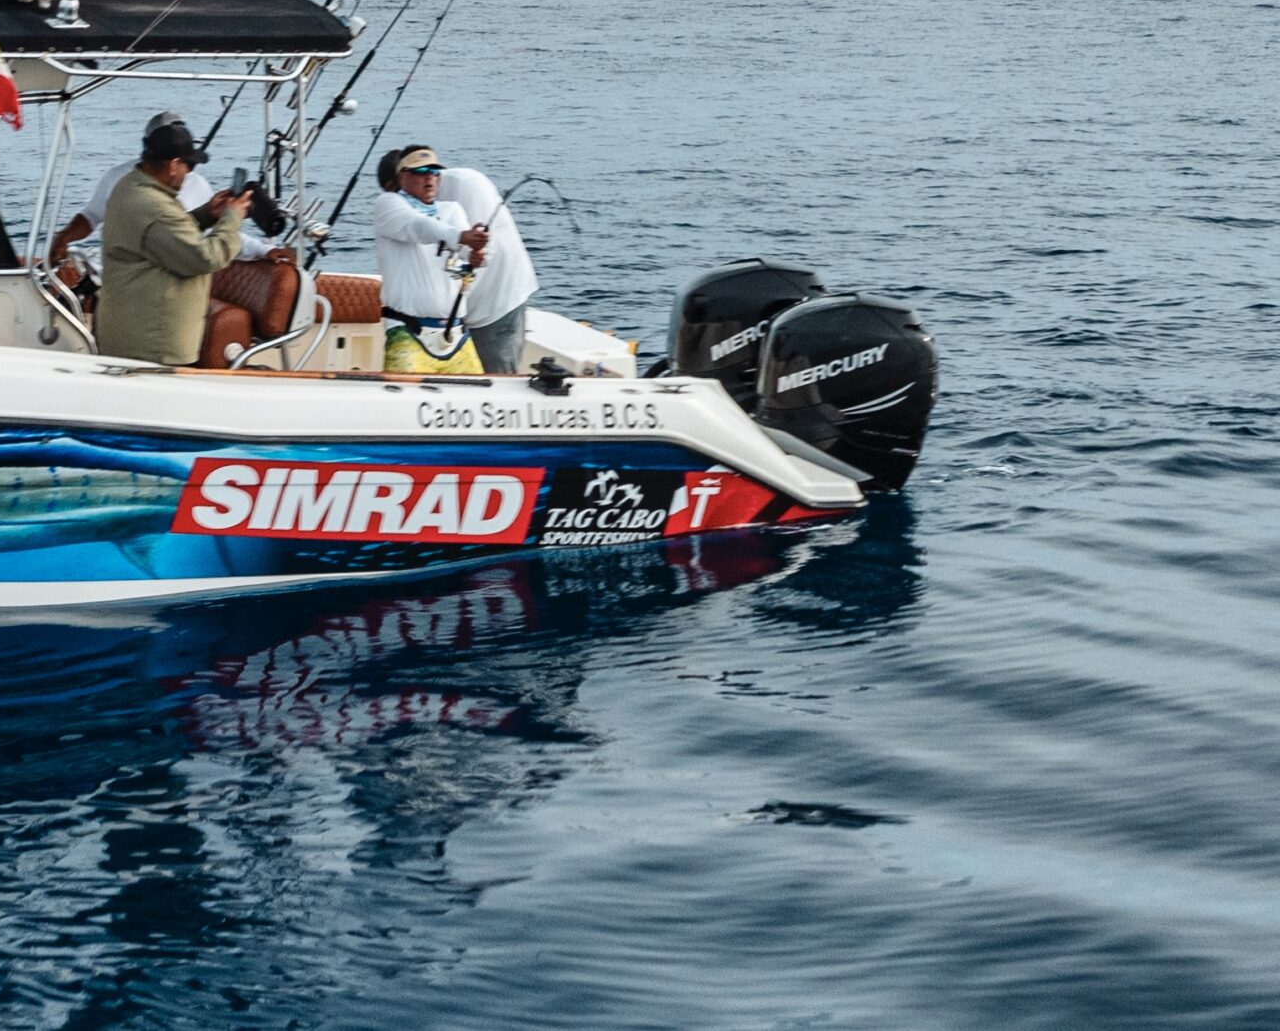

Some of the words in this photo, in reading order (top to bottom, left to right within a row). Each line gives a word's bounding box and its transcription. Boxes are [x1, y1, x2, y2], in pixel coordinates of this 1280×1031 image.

[710, 320, 769, 361] MERC
[777, 343, 890, 393] MERCURY
[418, 402, 474, 429] Cabo
[481, 402, 521, 429] San
[601, 403, 665, 429] B.C.S.
[191, 464, 526, 536] SIMRAD
[544, 508, 597, 529] TAG
[597, 508, 667, 529] CABO
